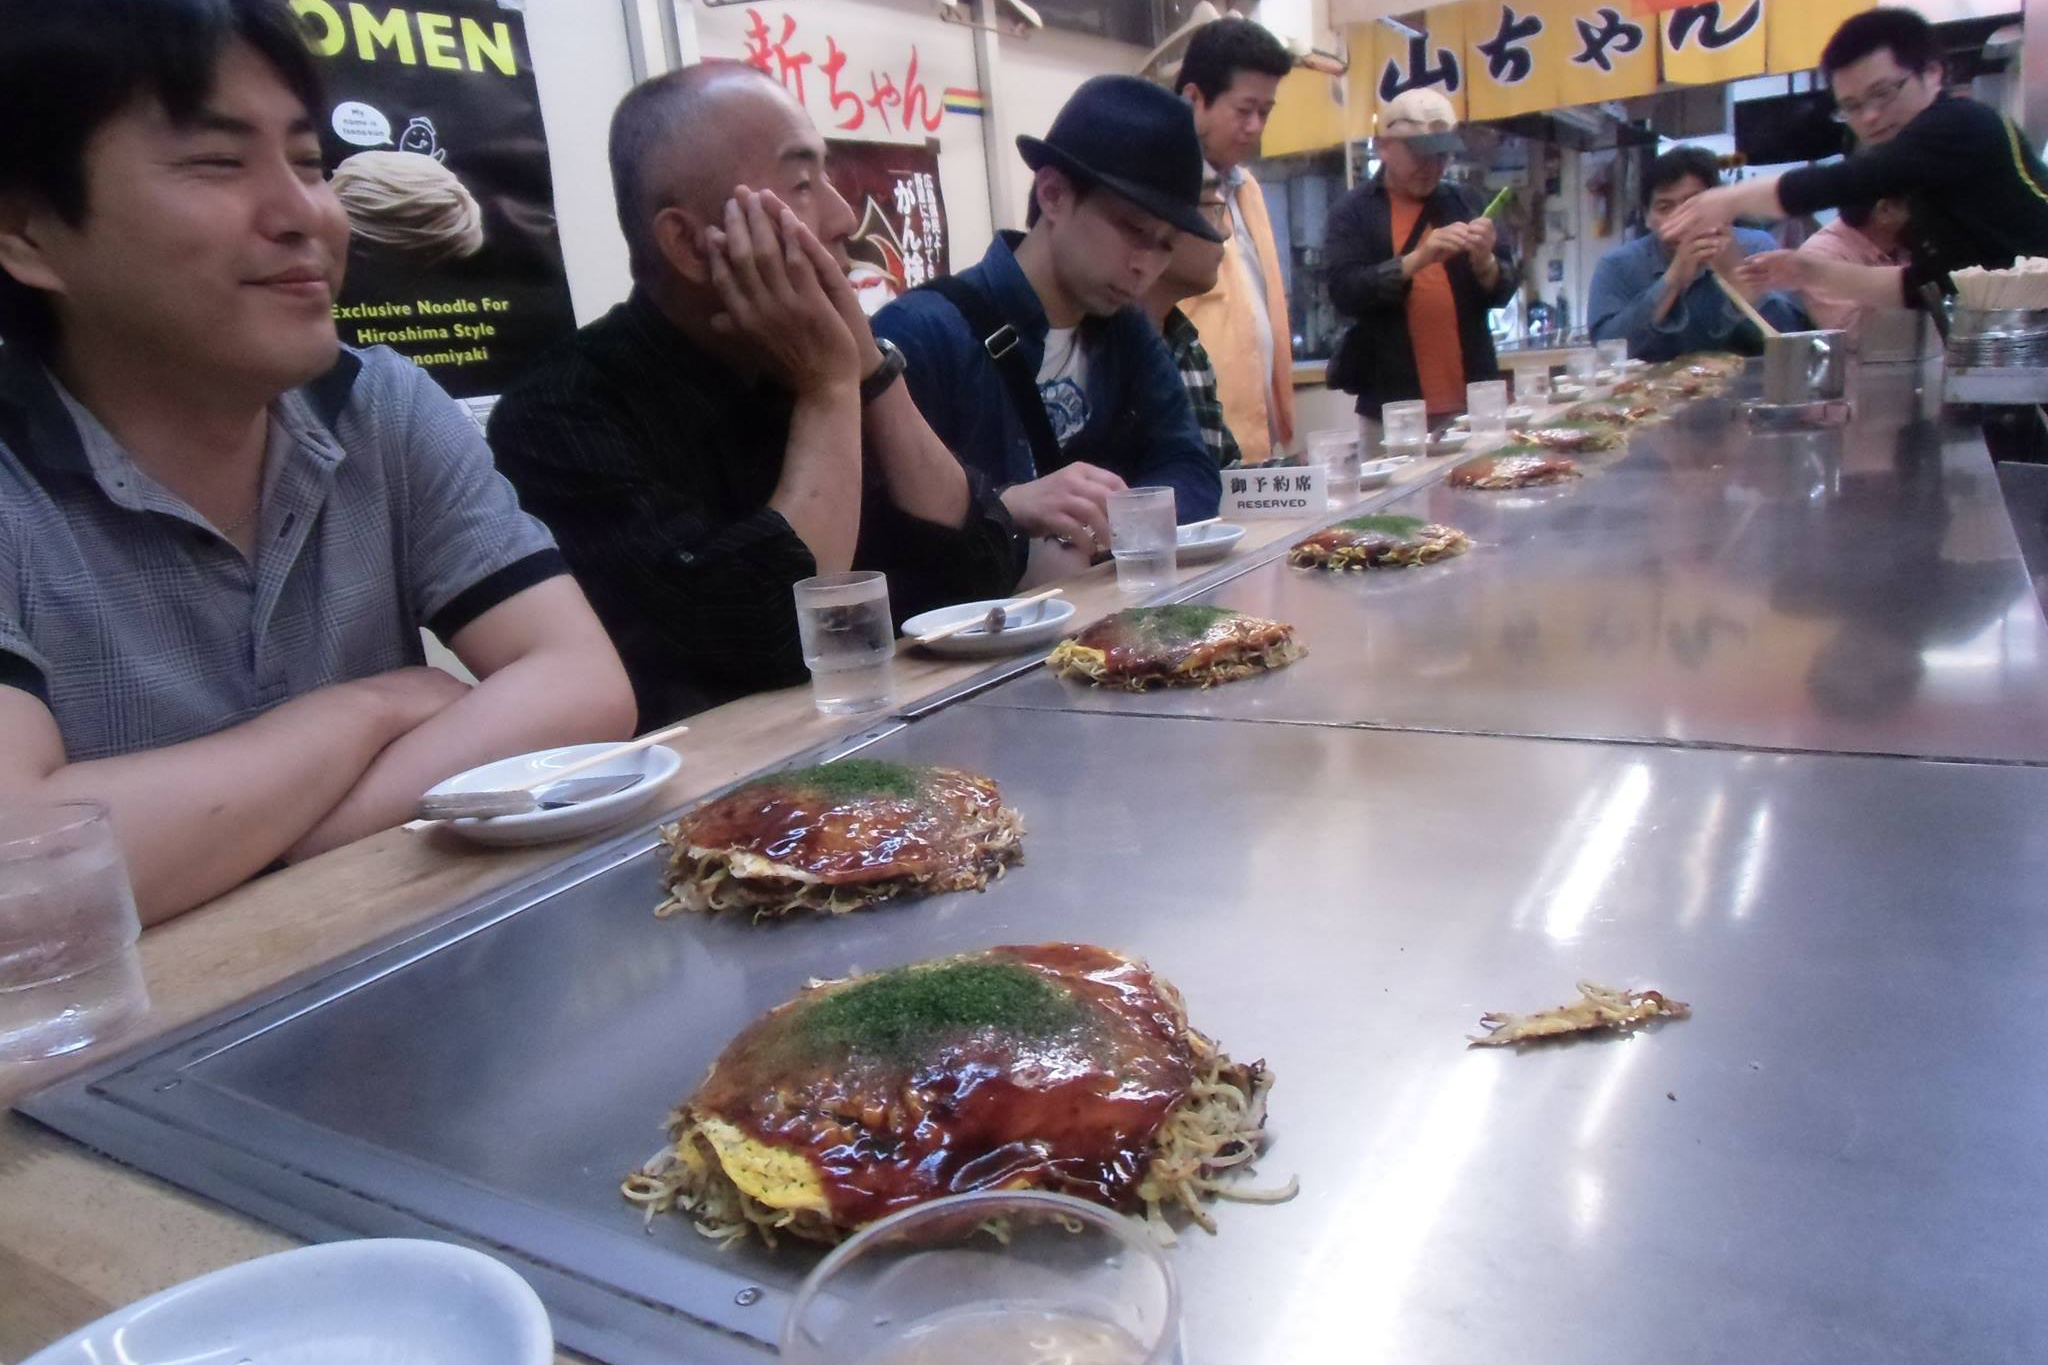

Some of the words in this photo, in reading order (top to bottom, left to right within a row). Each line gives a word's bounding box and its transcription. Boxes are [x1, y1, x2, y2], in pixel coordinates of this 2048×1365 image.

[744, 9, 943, 133] 新ちゃん
[331, 301, 412, 319] Exclusive
[416, 299, 478, 315] Noodle
[482, 297, 509, 313] For
[357, 325, 449, 344] Hiroshima
[453, 322, 496, 340] Style
[407, 346, 488, 366] nomiyaki
[1230, 475, 1311, 494] 御予約席
[1237, 498, 1307, 509] RESERVED
